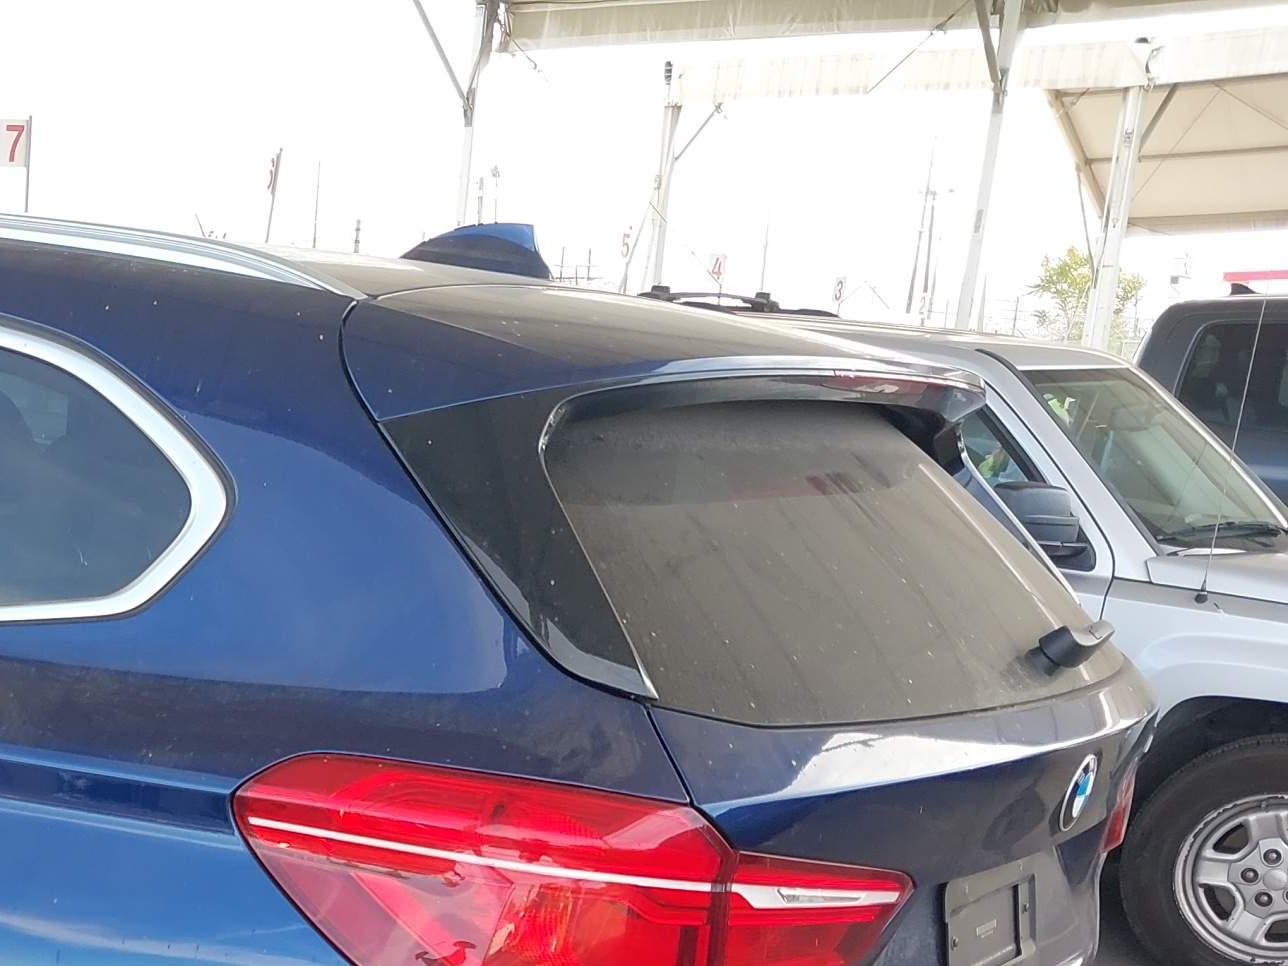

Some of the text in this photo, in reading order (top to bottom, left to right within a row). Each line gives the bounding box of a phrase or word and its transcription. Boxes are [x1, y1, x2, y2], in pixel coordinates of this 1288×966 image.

[6, 124, 25, 163] 7
[621, 233, 630, 258] 5
[712, 257, 722, 280] 4
[835, 280, 844, 301] 3
[919, 296, 926, 315] 2
